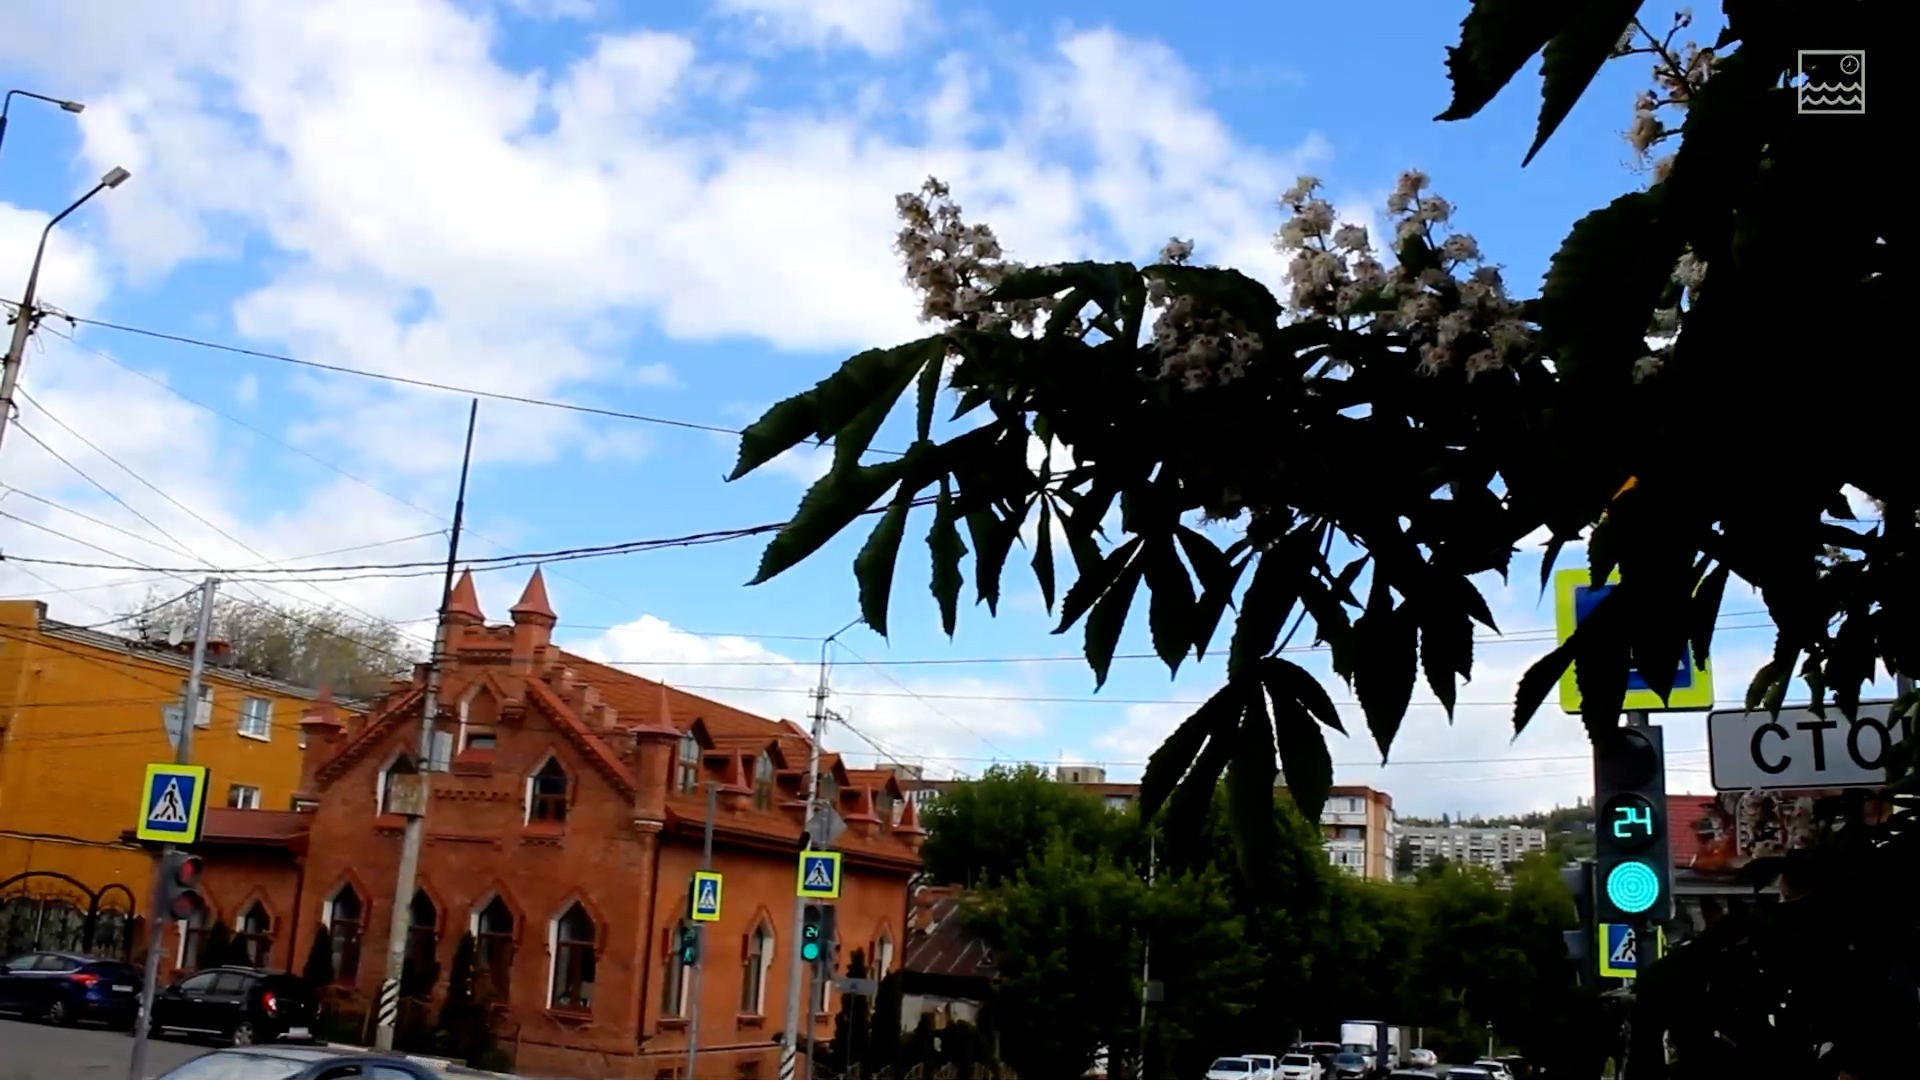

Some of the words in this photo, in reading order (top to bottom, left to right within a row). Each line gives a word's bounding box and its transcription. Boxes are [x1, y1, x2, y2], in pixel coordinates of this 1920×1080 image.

[1751, 716, 1913, 774] СТО
[1614, 806, 1652, 838] 24
[805, 926, 819, 938] 24
